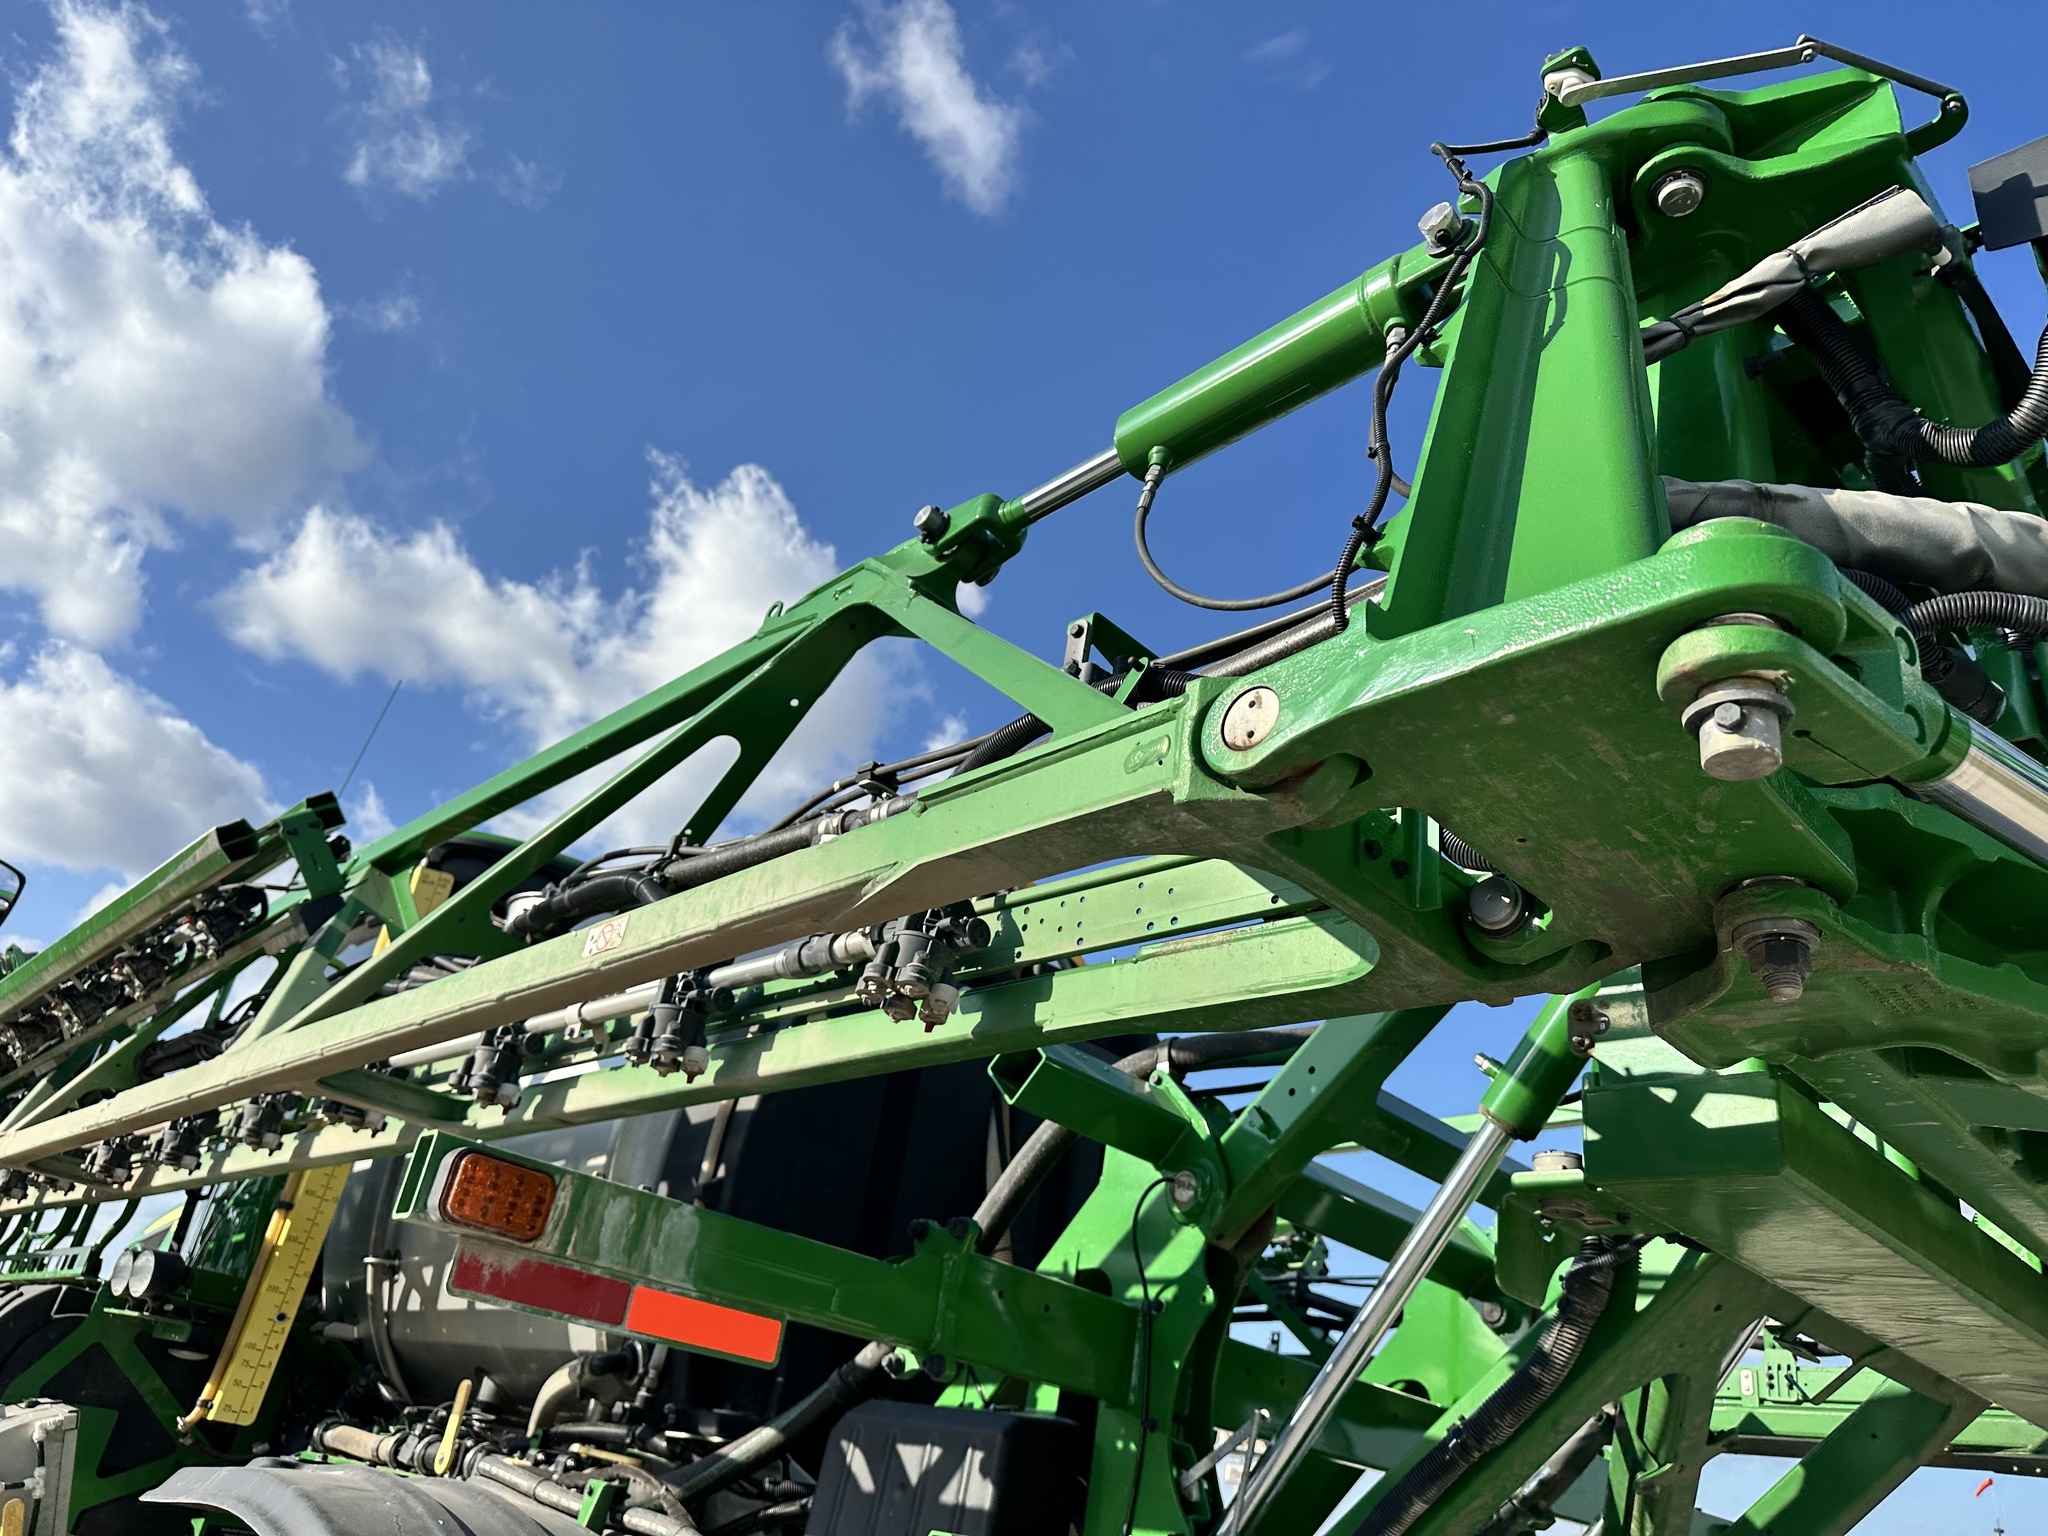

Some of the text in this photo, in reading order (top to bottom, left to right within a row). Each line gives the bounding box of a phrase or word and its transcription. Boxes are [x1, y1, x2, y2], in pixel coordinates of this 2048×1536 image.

[266, 1283, 280, 1294] 200
[244, 1341, 258, 1351] 100
[240, 1358, 250, 1368] 75
[232, 1378, 243, 1388] 50
[222, 1403, 233, 1413] 25
